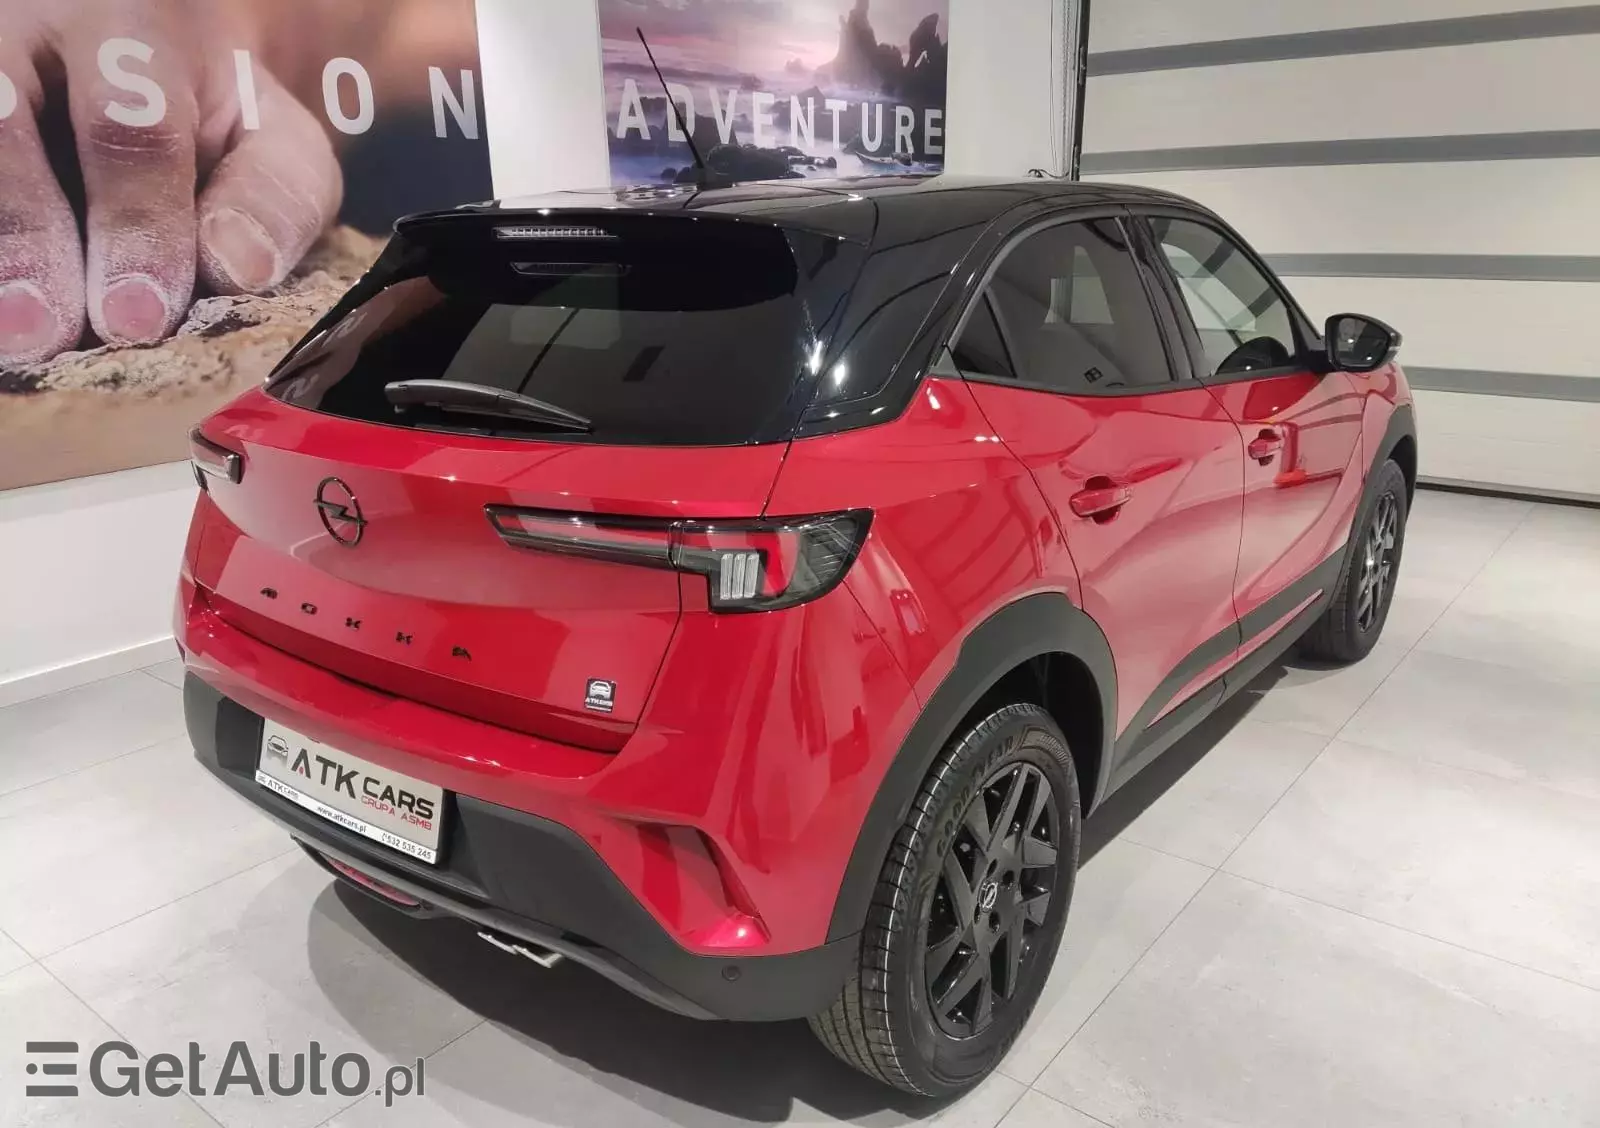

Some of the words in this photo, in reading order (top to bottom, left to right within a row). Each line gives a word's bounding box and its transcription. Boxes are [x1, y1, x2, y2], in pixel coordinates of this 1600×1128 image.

[616, 78, 944, 155] ADVENTURE
[260, 587, 472, 661] MOKKA
[291, 748, 360, 799] ATK
[362, 776, 435, 820] CARS
